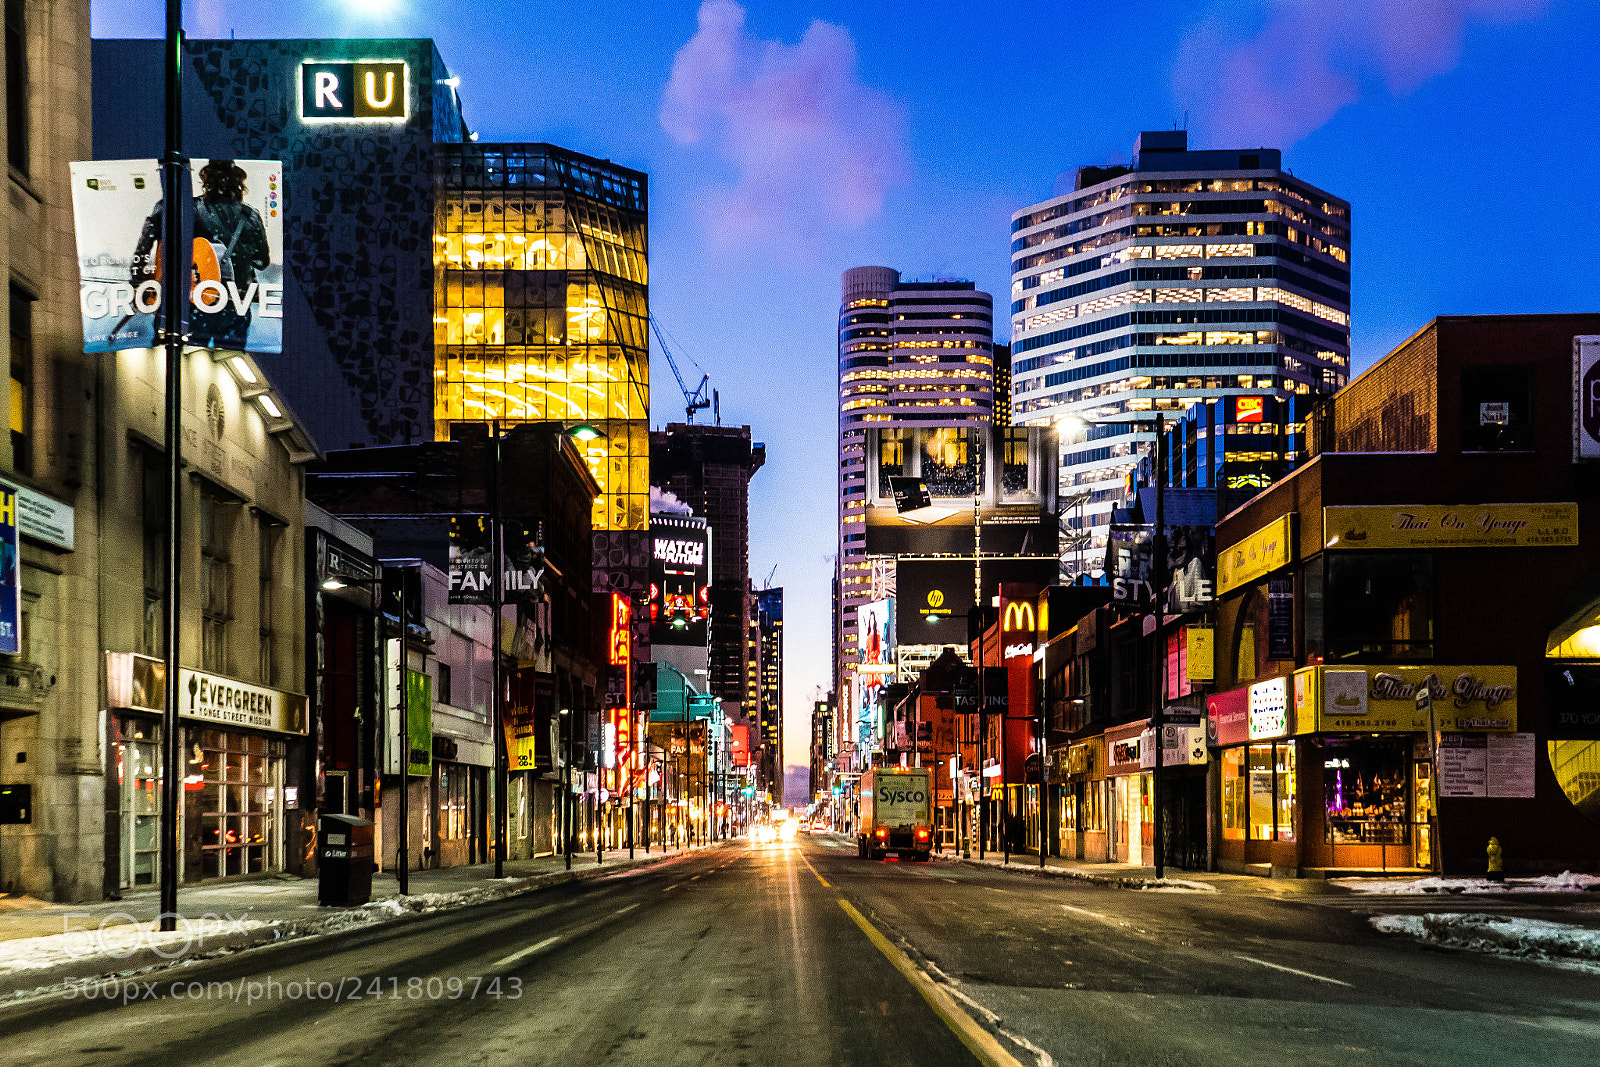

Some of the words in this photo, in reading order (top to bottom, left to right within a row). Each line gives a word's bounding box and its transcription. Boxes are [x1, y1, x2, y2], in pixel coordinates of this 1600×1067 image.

[1238, 399, 1261, 409] CIBC
[1391, 512, 1430, 530] Thai
[1440, 512, 1467, 529] On
[1475, 510, 1530, 535] Yonge
[654, 538, 703, 555] WATCH
[666, 552, 703, 565] FUTURE
[199, 677, 272, 715] EVERGREEN
[1370, 672, 1415, 700] Thai
[1452, 672, 1515, 710] Yonge
[199, 707, 220, 719] YONGE
[223, 711, 247, 722] STREET
[249, 716, 272, 726] MISSION
[879, 786, 924, 806] Sysco
